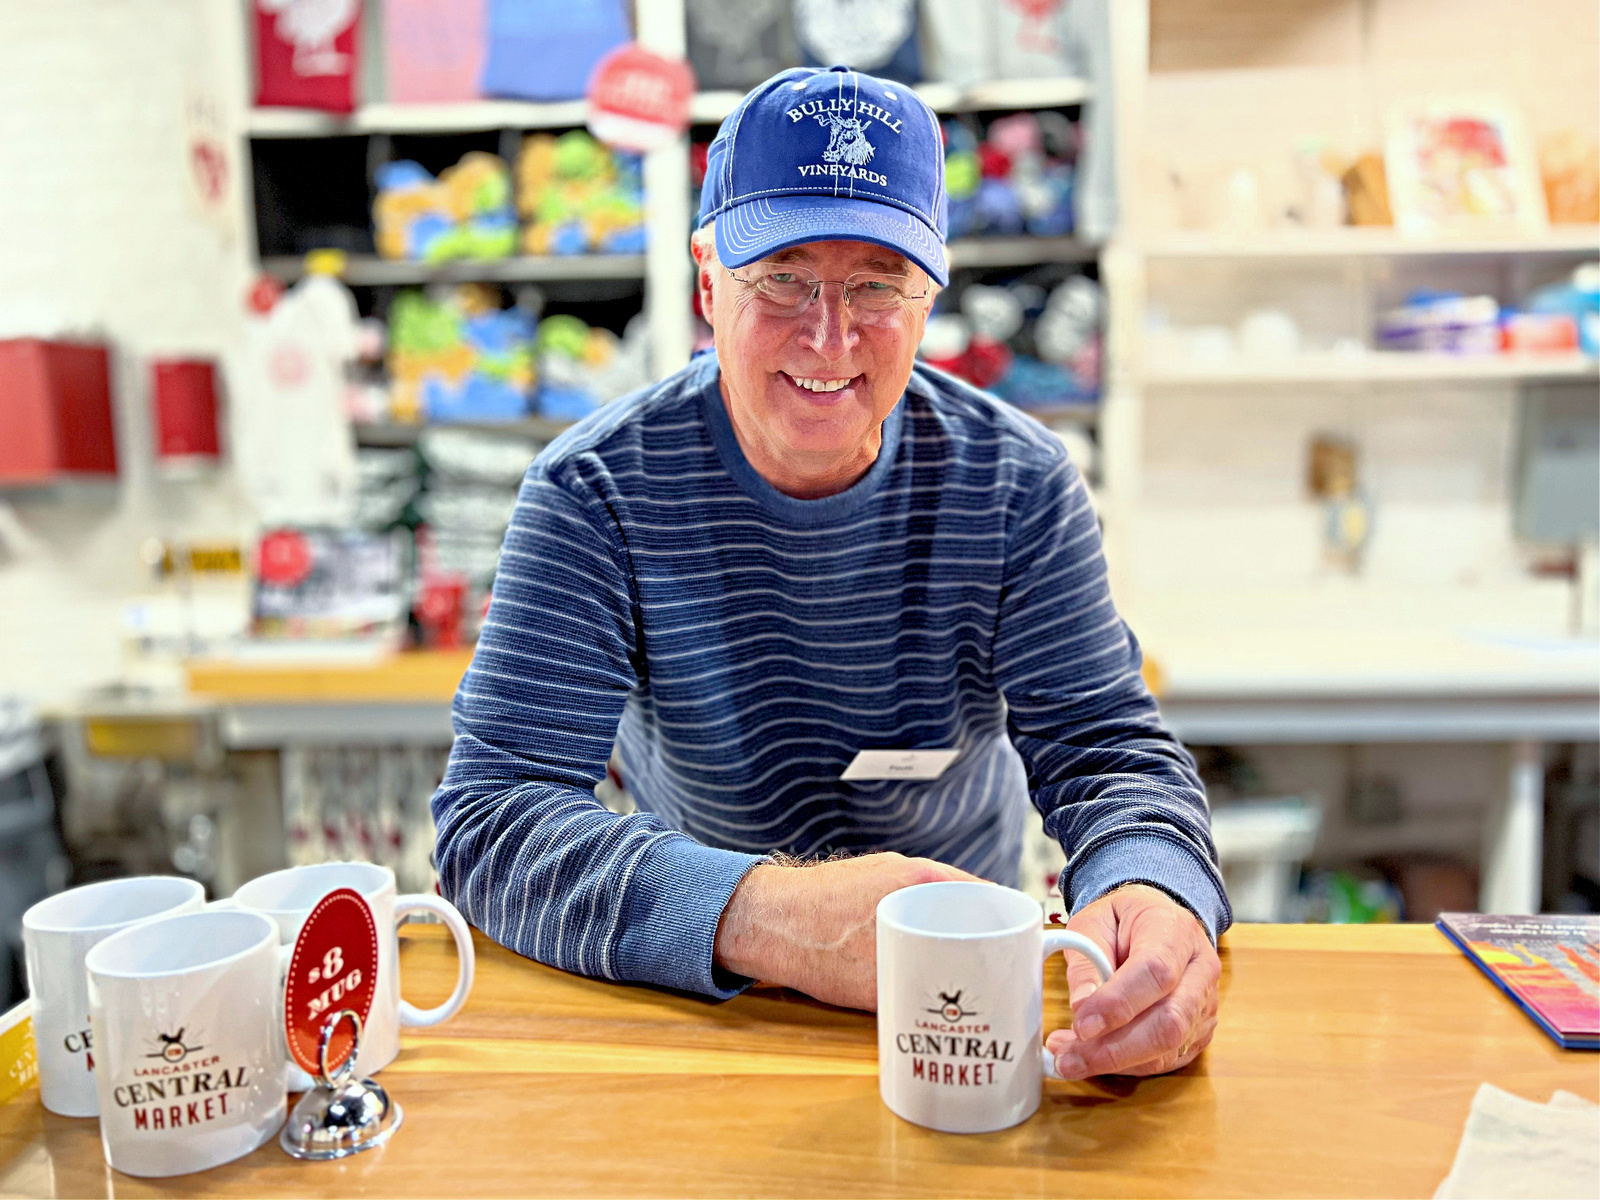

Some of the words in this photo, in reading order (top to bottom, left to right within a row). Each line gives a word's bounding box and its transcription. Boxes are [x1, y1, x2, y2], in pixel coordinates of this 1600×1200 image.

[787, 99, 854, 123] BULLY
[858, 101, 902, 134] HILL
[798, 164, 887, 187] VINEYARDS
[307, 968, 362, 1021] MUG
[915, 1019, 990, 1034] LANCASTER
[896, 1033, 1014, 1062] CENTRAL
[133, 1055, 220, 1077] LANCASTER
[913, 1057, 995, 1086] MARKET
[113, 1066, 250, 1108] CENTRAL
[134, 1092, 228, 1130] MARKET
